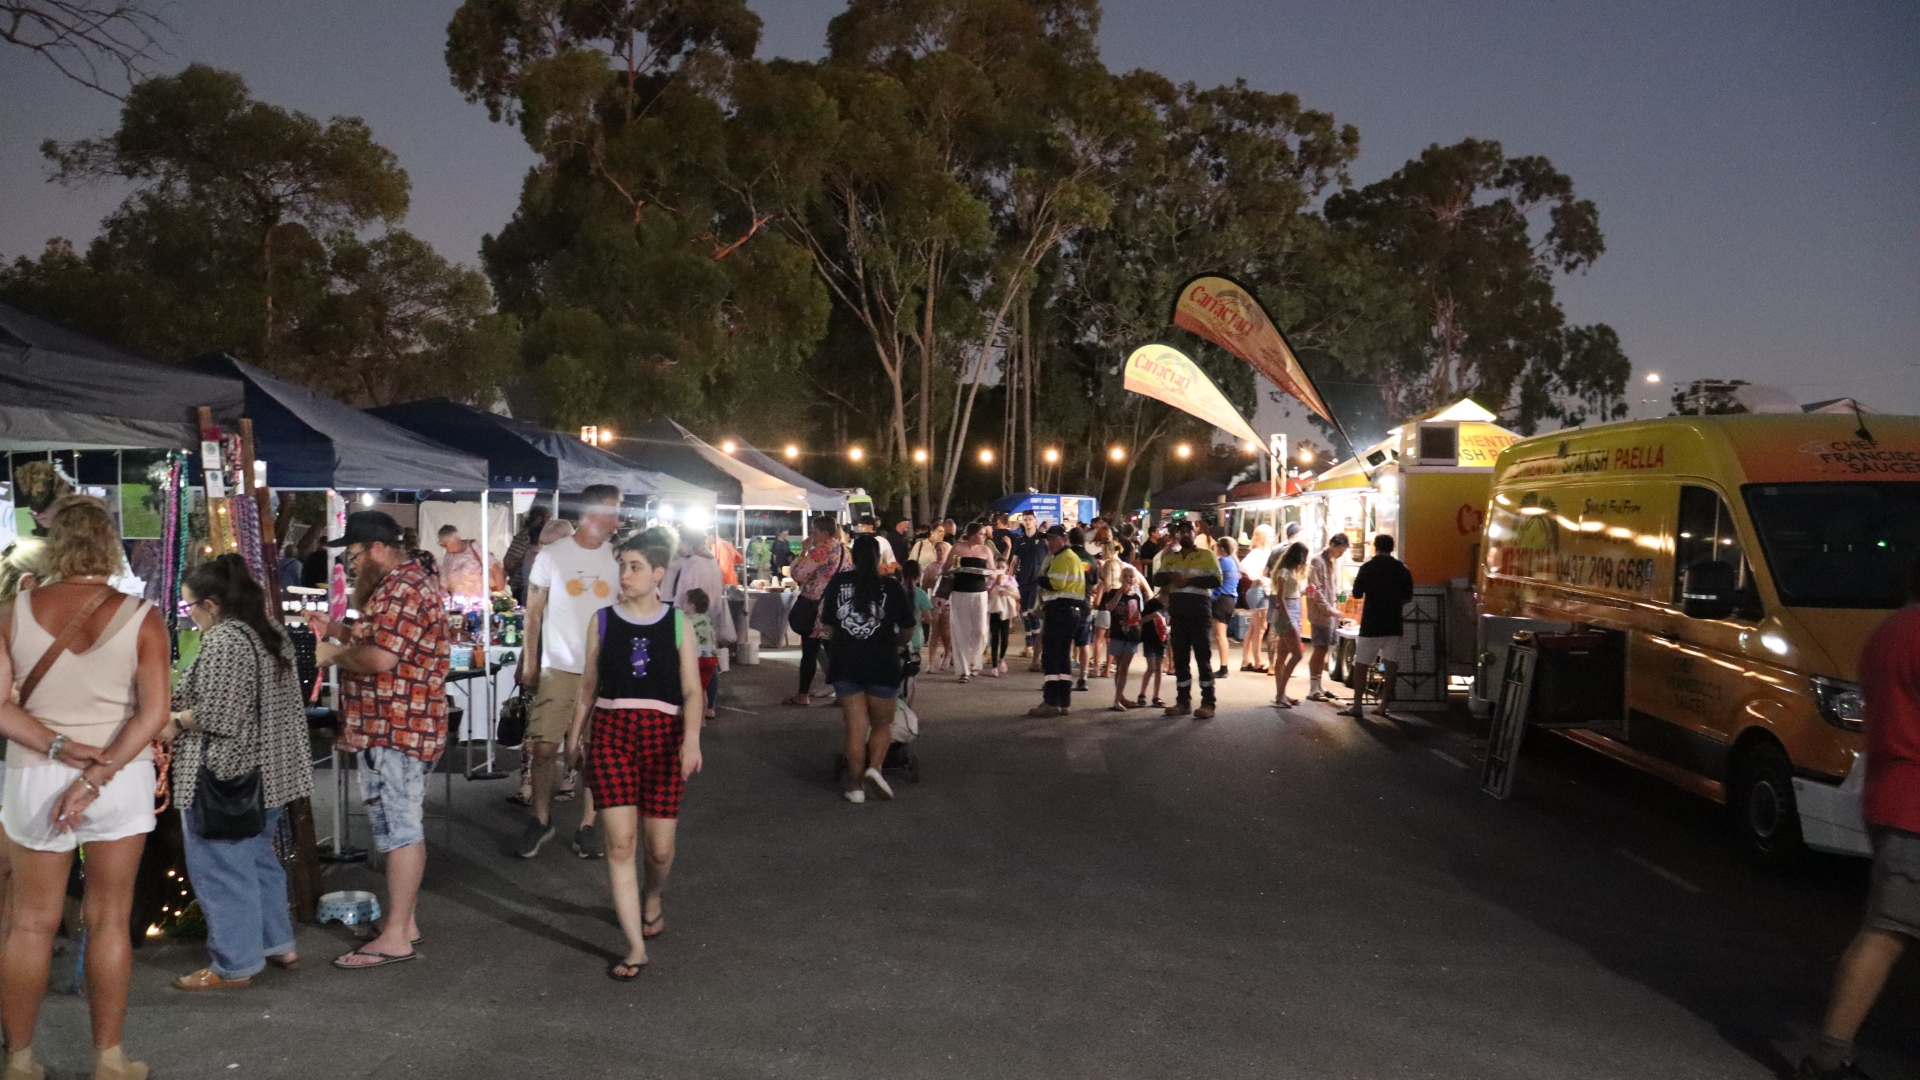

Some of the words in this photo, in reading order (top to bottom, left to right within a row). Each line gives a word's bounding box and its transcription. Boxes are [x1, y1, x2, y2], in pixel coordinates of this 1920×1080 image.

[1189, 286, 1255, 336] Canarian
[1135, 353, 1191, 390] Canarian
[1615, 444, 1665, 471] PAELLA
[1831, 439, 1878, 452] CHEF
[1588, 556, 1613, 587] 209
